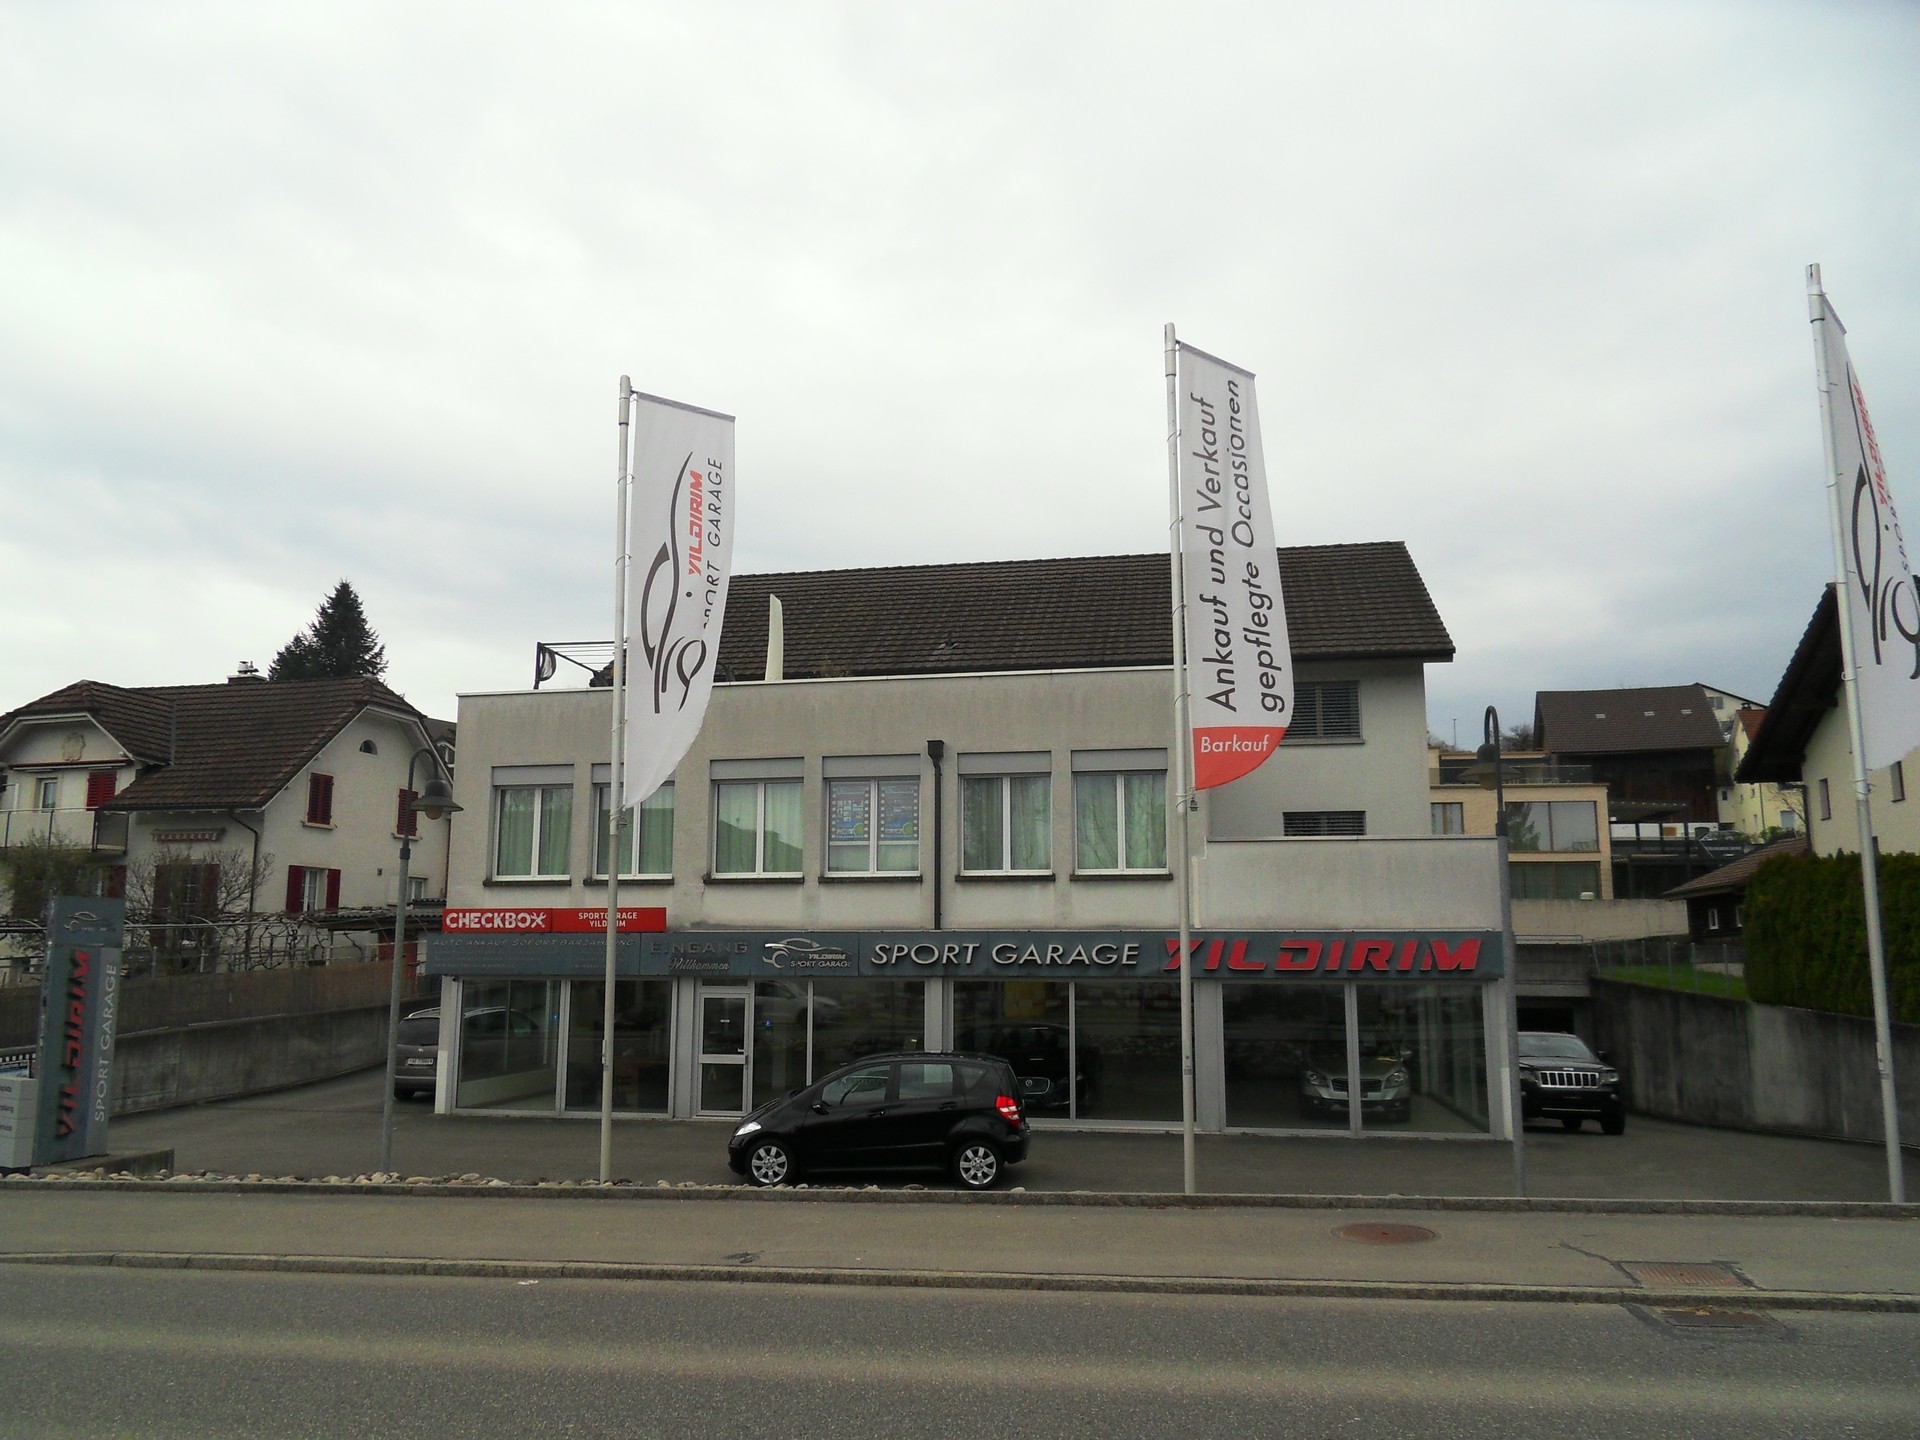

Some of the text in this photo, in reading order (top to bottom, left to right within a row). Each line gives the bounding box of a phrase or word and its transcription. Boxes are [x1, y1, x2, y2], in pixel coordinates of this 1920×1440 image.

[688, 469, 703, 576] YILDIRIM
[707, 457, 723, 548] GARAGE
[1190, 392, 1238, 713] Ankauf und Verkauf
[1226, 379, 1286, 714] gepflegte Occasionen
[1200, 734, 1270, 754] Barkauf
[870, 938, 1482, 971] SPORT GARAGE YILDIRIM
[56, 949, 91, 1140] YILDIRIM
[94, 963, 117, 1123] SPORT GARAGE
